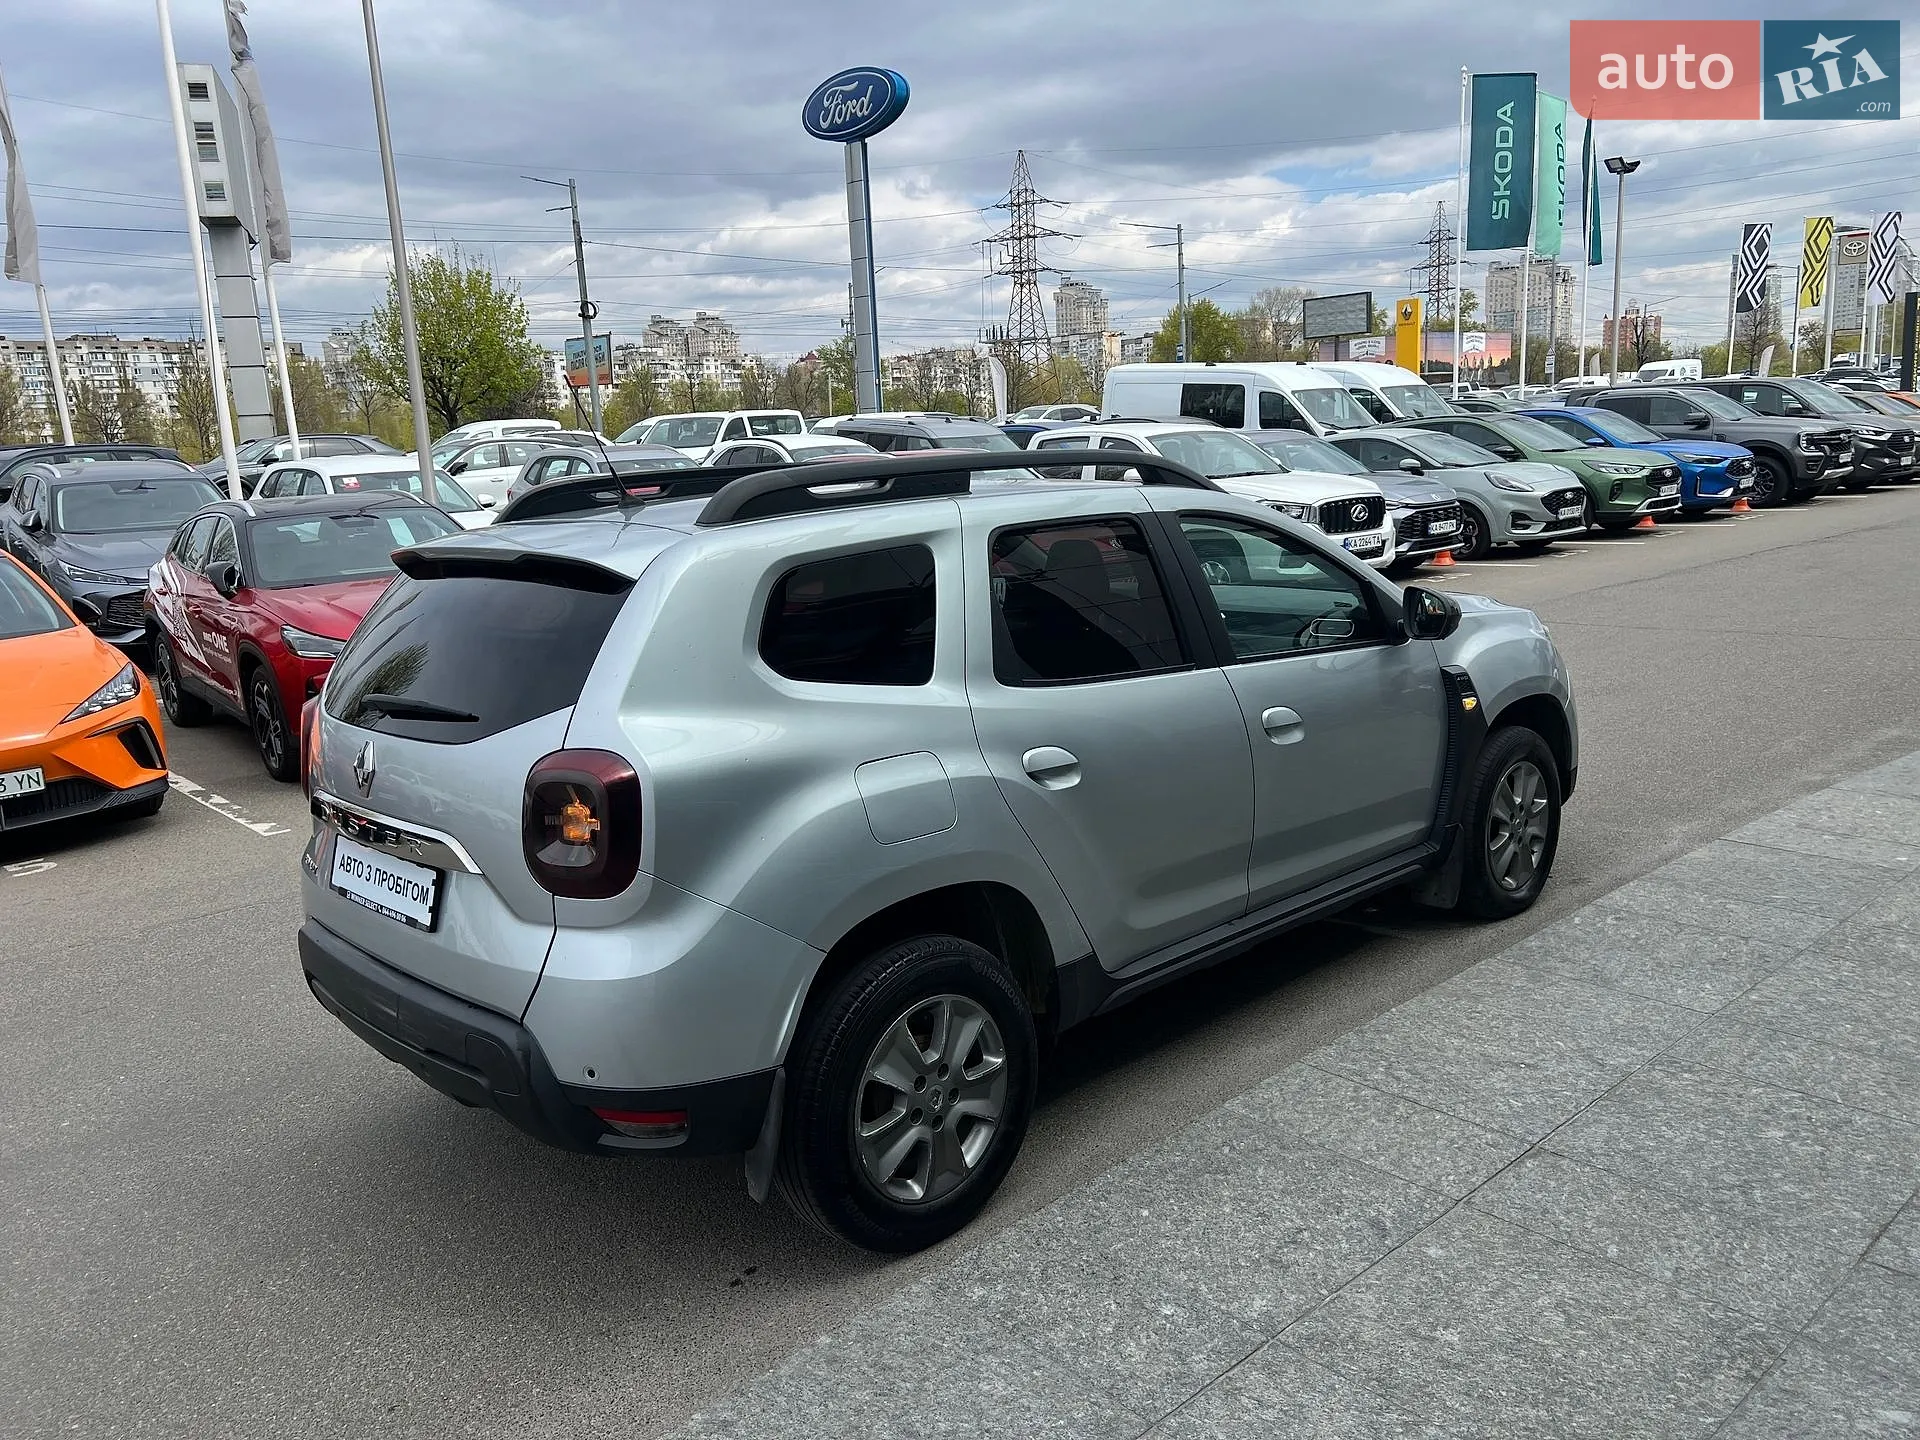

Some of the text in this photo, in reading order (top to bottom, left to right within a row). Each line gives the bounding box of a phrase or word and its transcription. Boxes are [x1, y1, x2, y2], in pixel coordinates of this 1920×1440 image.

[819, 81, 874, 129] Ford
[1349, 539, 1358, 549] KA
[1372, 535, 1381, 546] TA
[212, 631, 230, 653] ONE
[14, 772, 41, 790] YN
[320, 802, 425, 857] DUSTER
[338, 853, 364, 879] АВТО
[373, 867, 430, 906] ПРОБІГОМ
